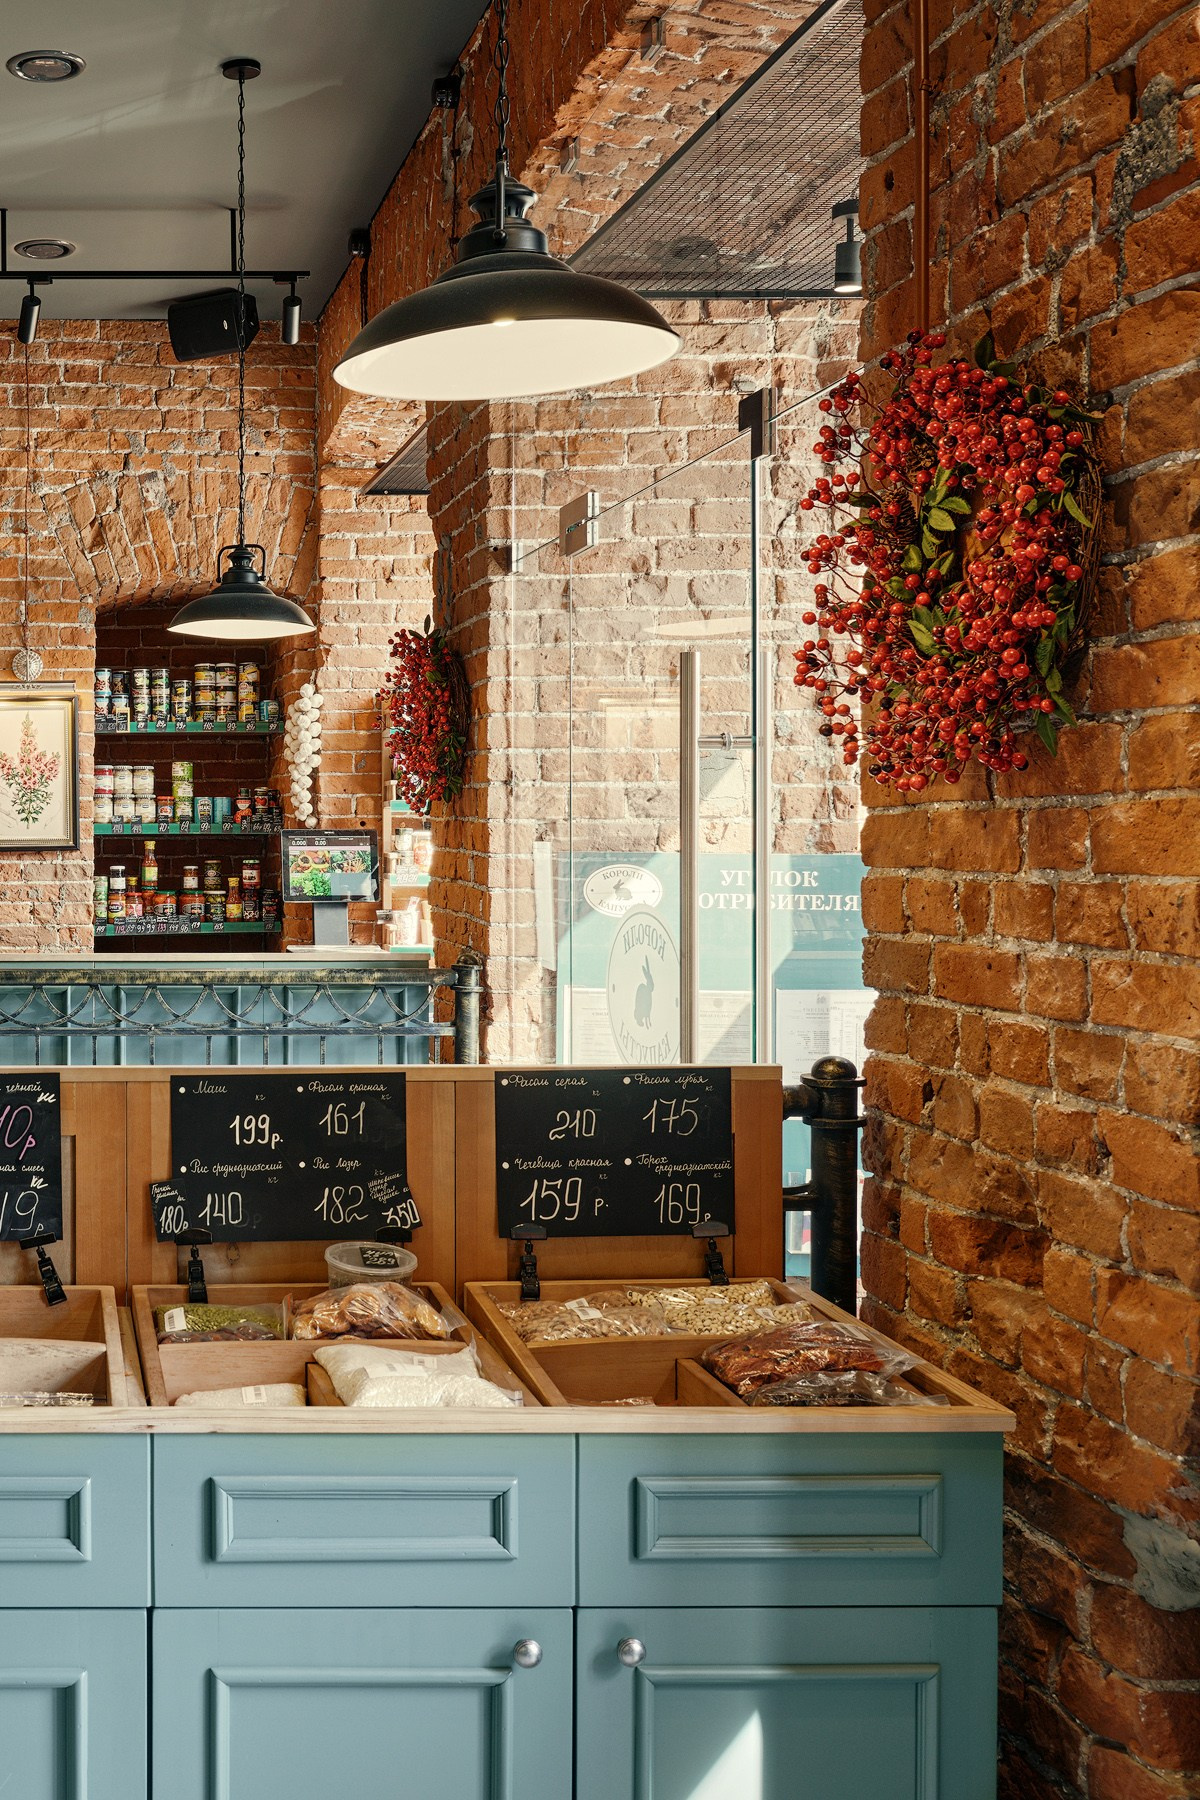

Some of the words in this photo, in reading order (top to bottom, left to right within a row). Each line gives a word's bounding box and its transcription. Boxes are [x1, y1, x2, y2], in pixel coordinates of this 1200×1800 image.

[602, 869, 644, 880] КОРОЛИ
[719, 869, 819, 888] УГЛОК
[598, 899, 647, 912] КАПУС
[698, 892, 860, 911] ОТРИТЕЛЯ
[192, 1080, 228, 1095] Маш
[308, 1080, 344, 1093] Фасоль
[348, 1081, 388, 1095] красная
[508, 1074, 549, 1088] Фасоль
[554, 1078, 588, 1093] серая
[633, 1073, 670, 1086] Фасоль
[319, 1101, 367, 1136] 161
[549, 1108, 596, 1141] 210
[642, 1097, 700, 1136] 175
[21, 1164, 45, 1172] смесь
[189, 1158, 209, 1174] Рис
[313, 1156, 330, 1170] Рис
[514, 1155, 563, 1170] Чечевица
[568, 1157, 614, 1170] красная
[636, 1153, 669, 1170] Горох
[313, 1185, 369, 1224] 182
[520, 1177, 582, 1222] 159
[198, 1191, 243, 1227] 140
